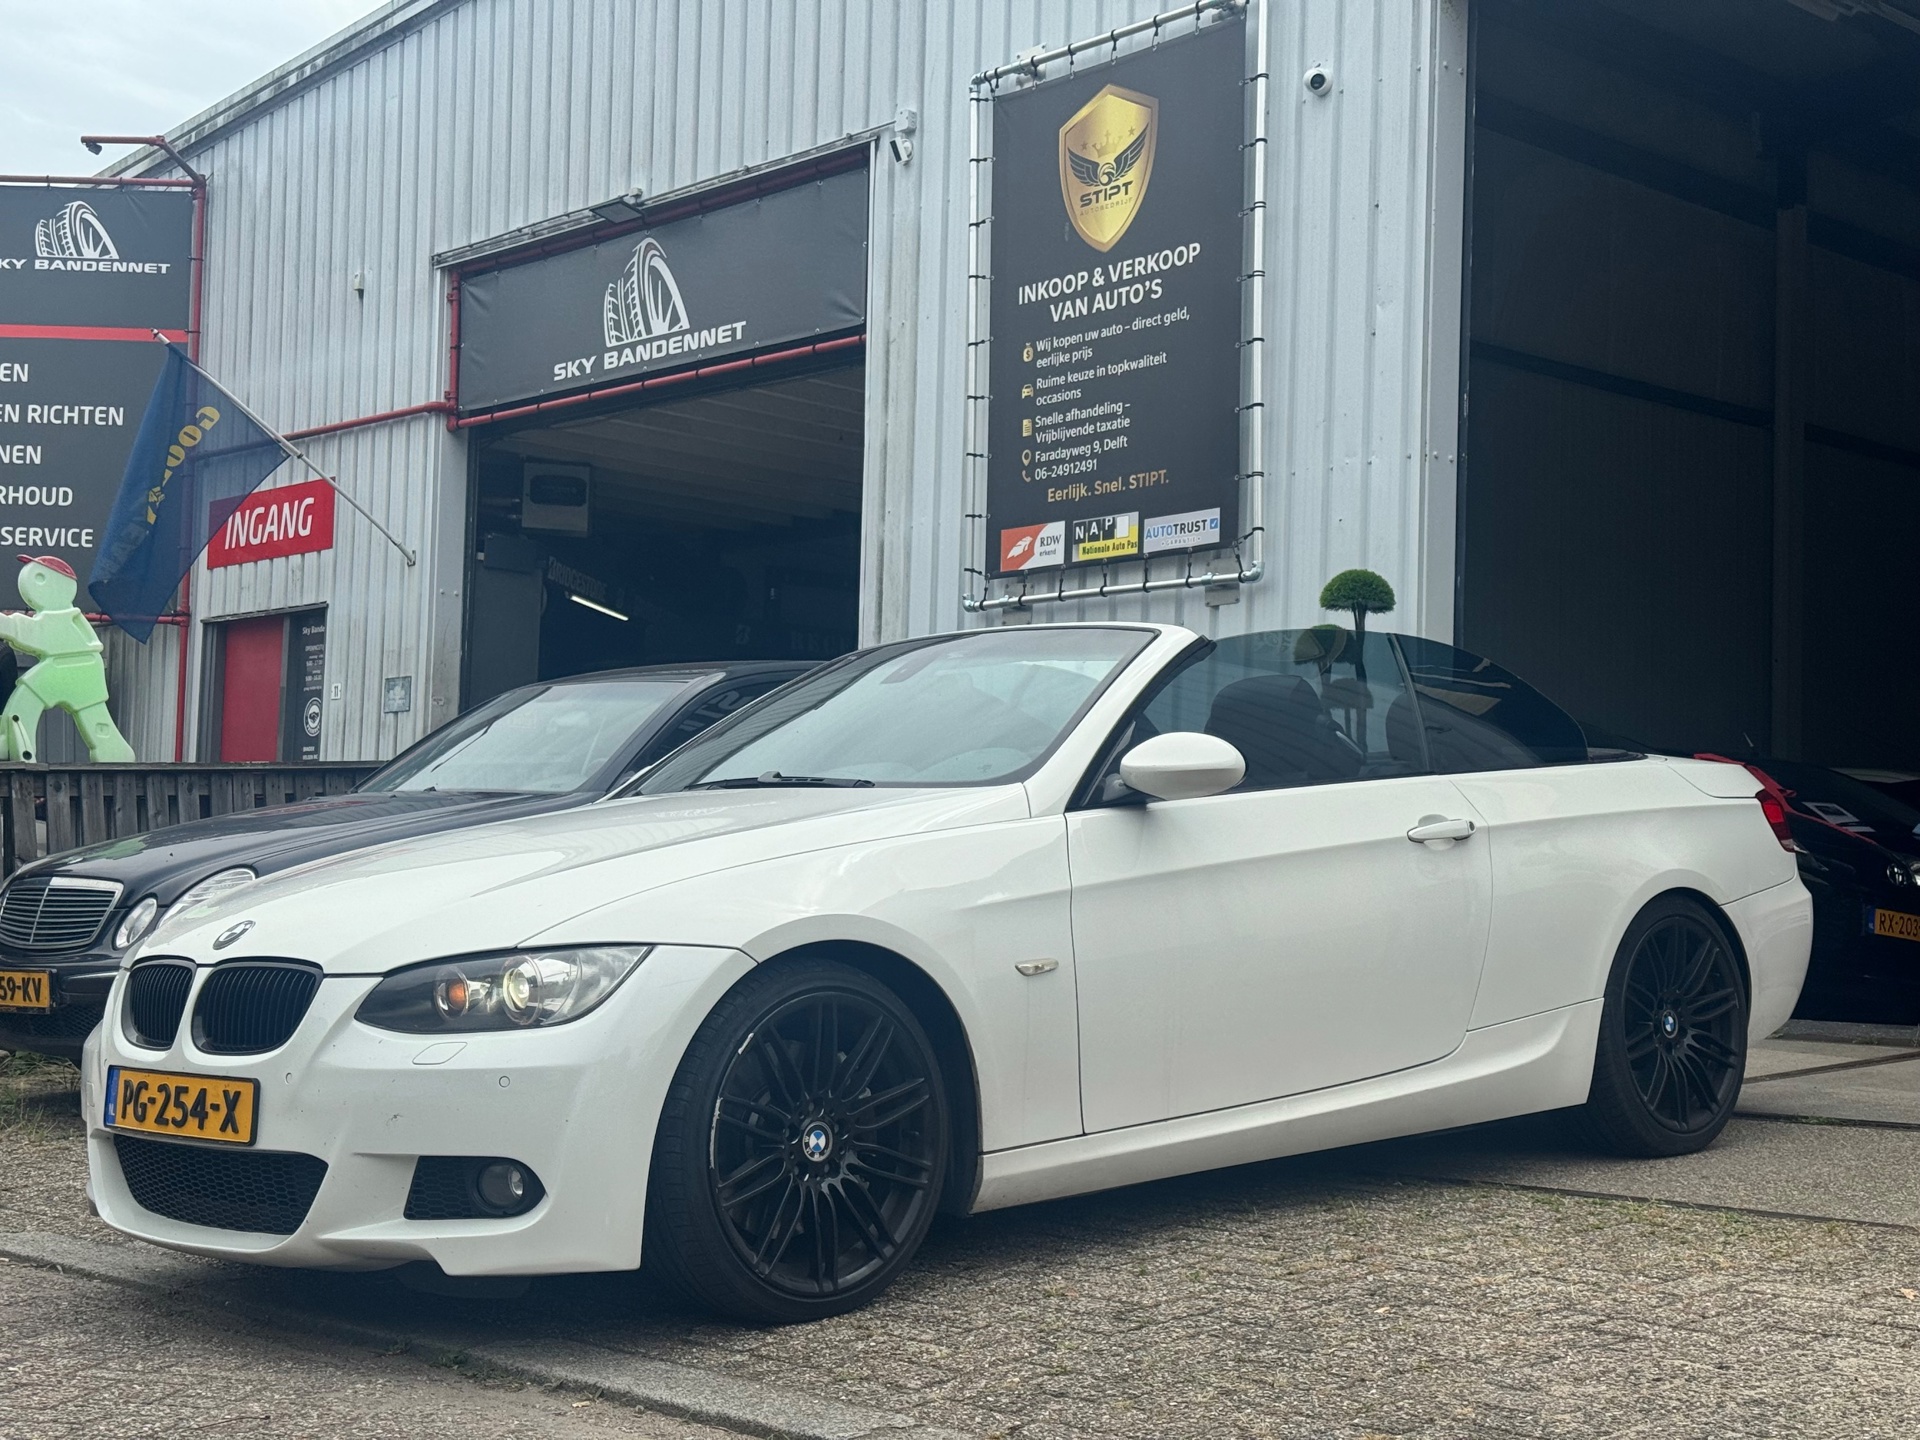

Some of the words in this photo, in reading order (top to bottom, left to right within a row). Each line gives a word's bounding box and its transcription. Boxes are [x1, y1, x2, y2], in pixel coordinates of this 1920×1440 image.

[1080, 180, 1133, 208] STIPT
[35, 259, 171, 274] BANDENNET
[1018, 271, 1088, 305] INKOOP
[1092, 268, 1105, 287] &
[1108, 243, 1201, 282] VERKOOP
[1050, 298, 1088, 323] VAN
[1092, 279, 1163, 314] AUTO'S
[1036, 338, 1051, 352] Wij
[1053, 333, 1083, 350] kopen
[1084, 329, 1099, 342] uw
[1101, 324, 1123, 338] auto
[1132, 314, 1162, 331] direct
[1163, 306, 1190, 326] geld,
[554, 355, 597, 381] SKY
[603, 321, 747, 370] BANDENNET
[1036, 352, 1070, 368] eerlijke
[1072, 347, 1093, 364] prijs
[0, 363, 29, 382] EN
[1036, 376, 1066, 389] Ruime
[1067, 368, 1095, 384] keuze
[1096, 365, 1106, 377] in
[1107, 352, 1168, 376] topkwaliteit
[1036, 388, 1082, 406] occasions
[0, 404, 20, 423] N
[27, 404, 124, 426] RICHTEN
[1035, 412, 1063, 428] Snelle
[1065, 402, 1123, 422] afhandeling
[1035, 423, 1094, 444] Vrijblijvende
[1096, 415, 1131, 431] taxatie
[0, 444, 42, 465] NEN
[1035, 444, 1091, 463] Faradayweg
[1104, 435, 1128, 450] Delft
[1035, 458, 1097, 481] 06-24912491
[1047, 483, 1092, 502] Eerlijk.
[1094, 477, 1126, 495] Snel.
[1128, 469, 1169, 490] STIPT.
[224, 497, 315, 550] INGANG
[1075, 517, 1113, 540] NAP
[1145, 519, 1208, 540] AUTOTRUST
[0, 526, 94, 548] SERVICE
[1039, 535, 1061, 547] RDW
[1082, 543, 1110, 555] Nationale
[1112, 541, 1126, 551] Auto
[1126, 540, 1138, 549] Pas
[1039, 548, 1057, 557] erkend
[0, 976, 42, 1003] 59-KV
[121, 1079, 242, 1135] PG-254-X
